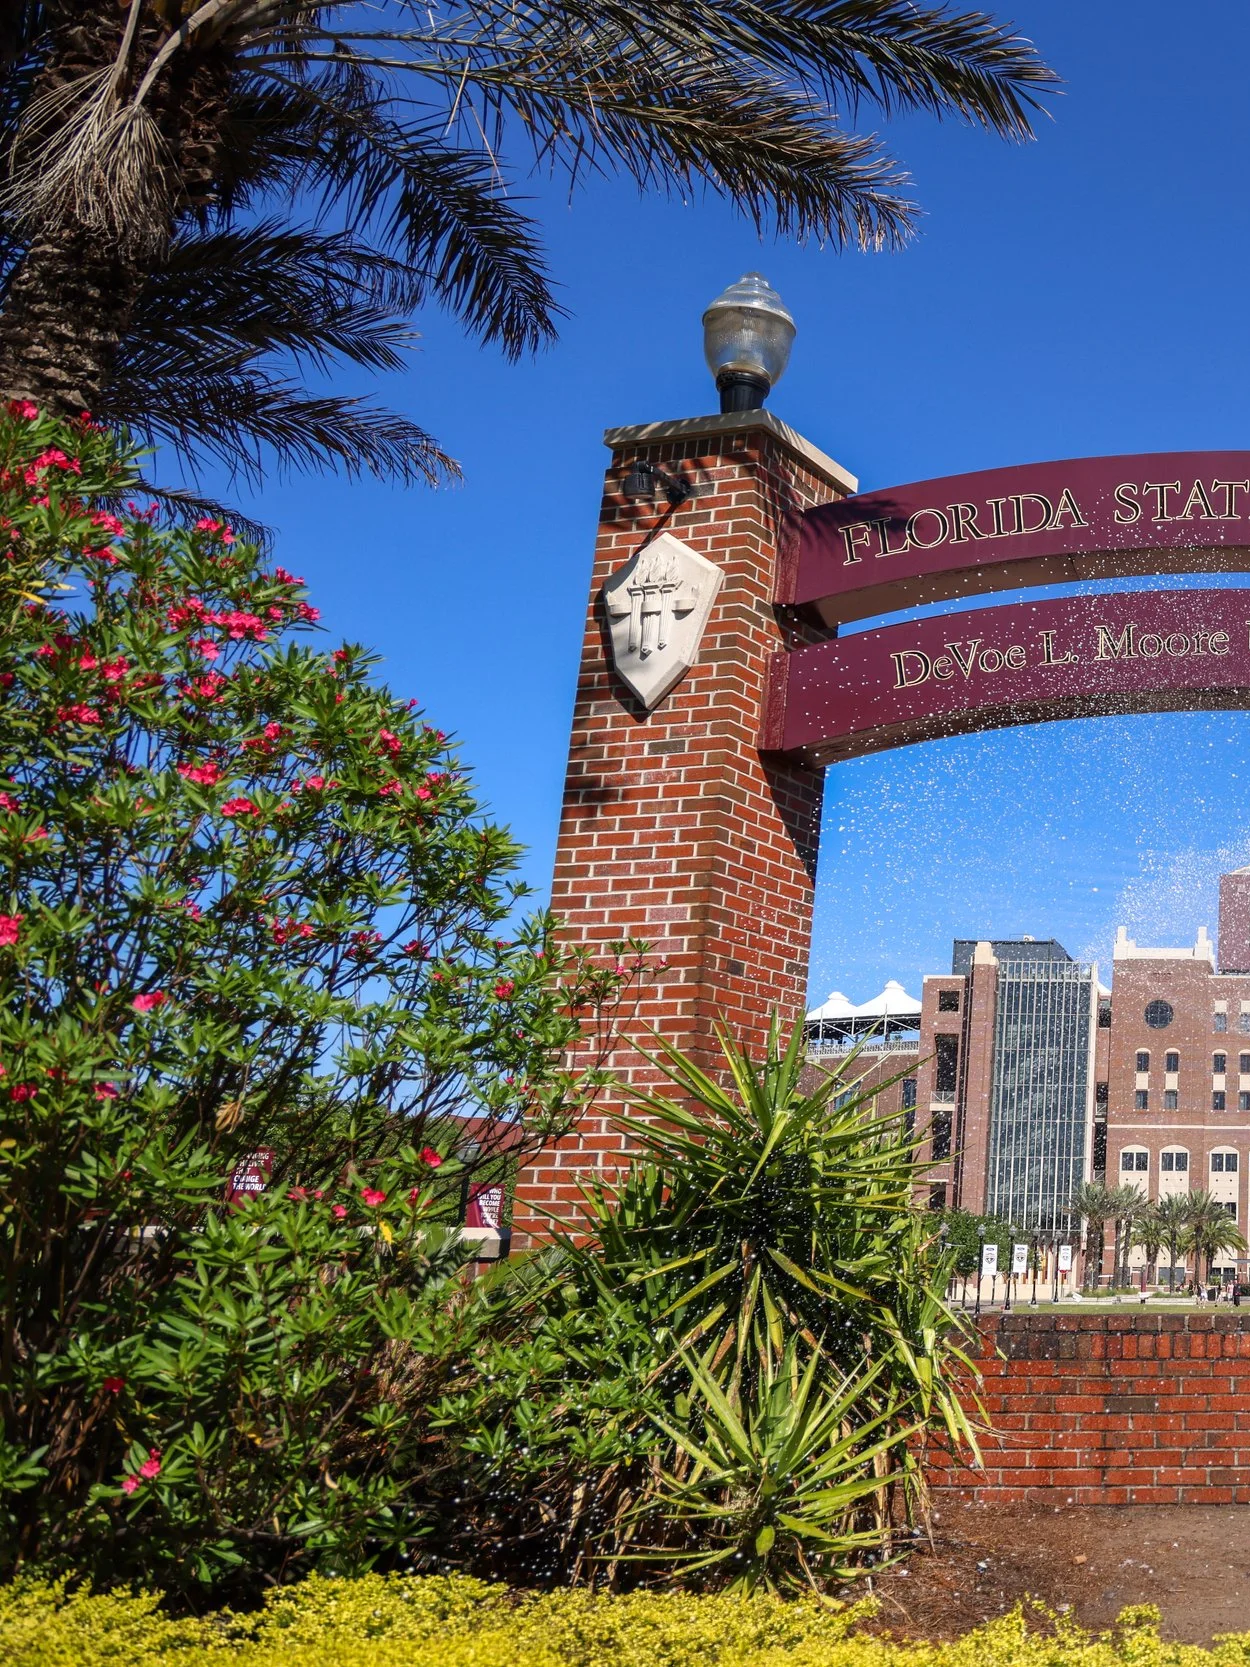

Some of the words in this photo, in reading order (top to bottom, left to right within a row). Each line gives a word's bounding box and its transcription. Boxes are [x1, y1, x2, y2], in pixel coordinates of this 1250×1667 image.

[838, 487, 1089, 566] FLORIDA
[890, 638, 1027, 690] DeVoe
[1039, 629, 1080, 666] L.
[1094, 622, 1230, 661] Moore
